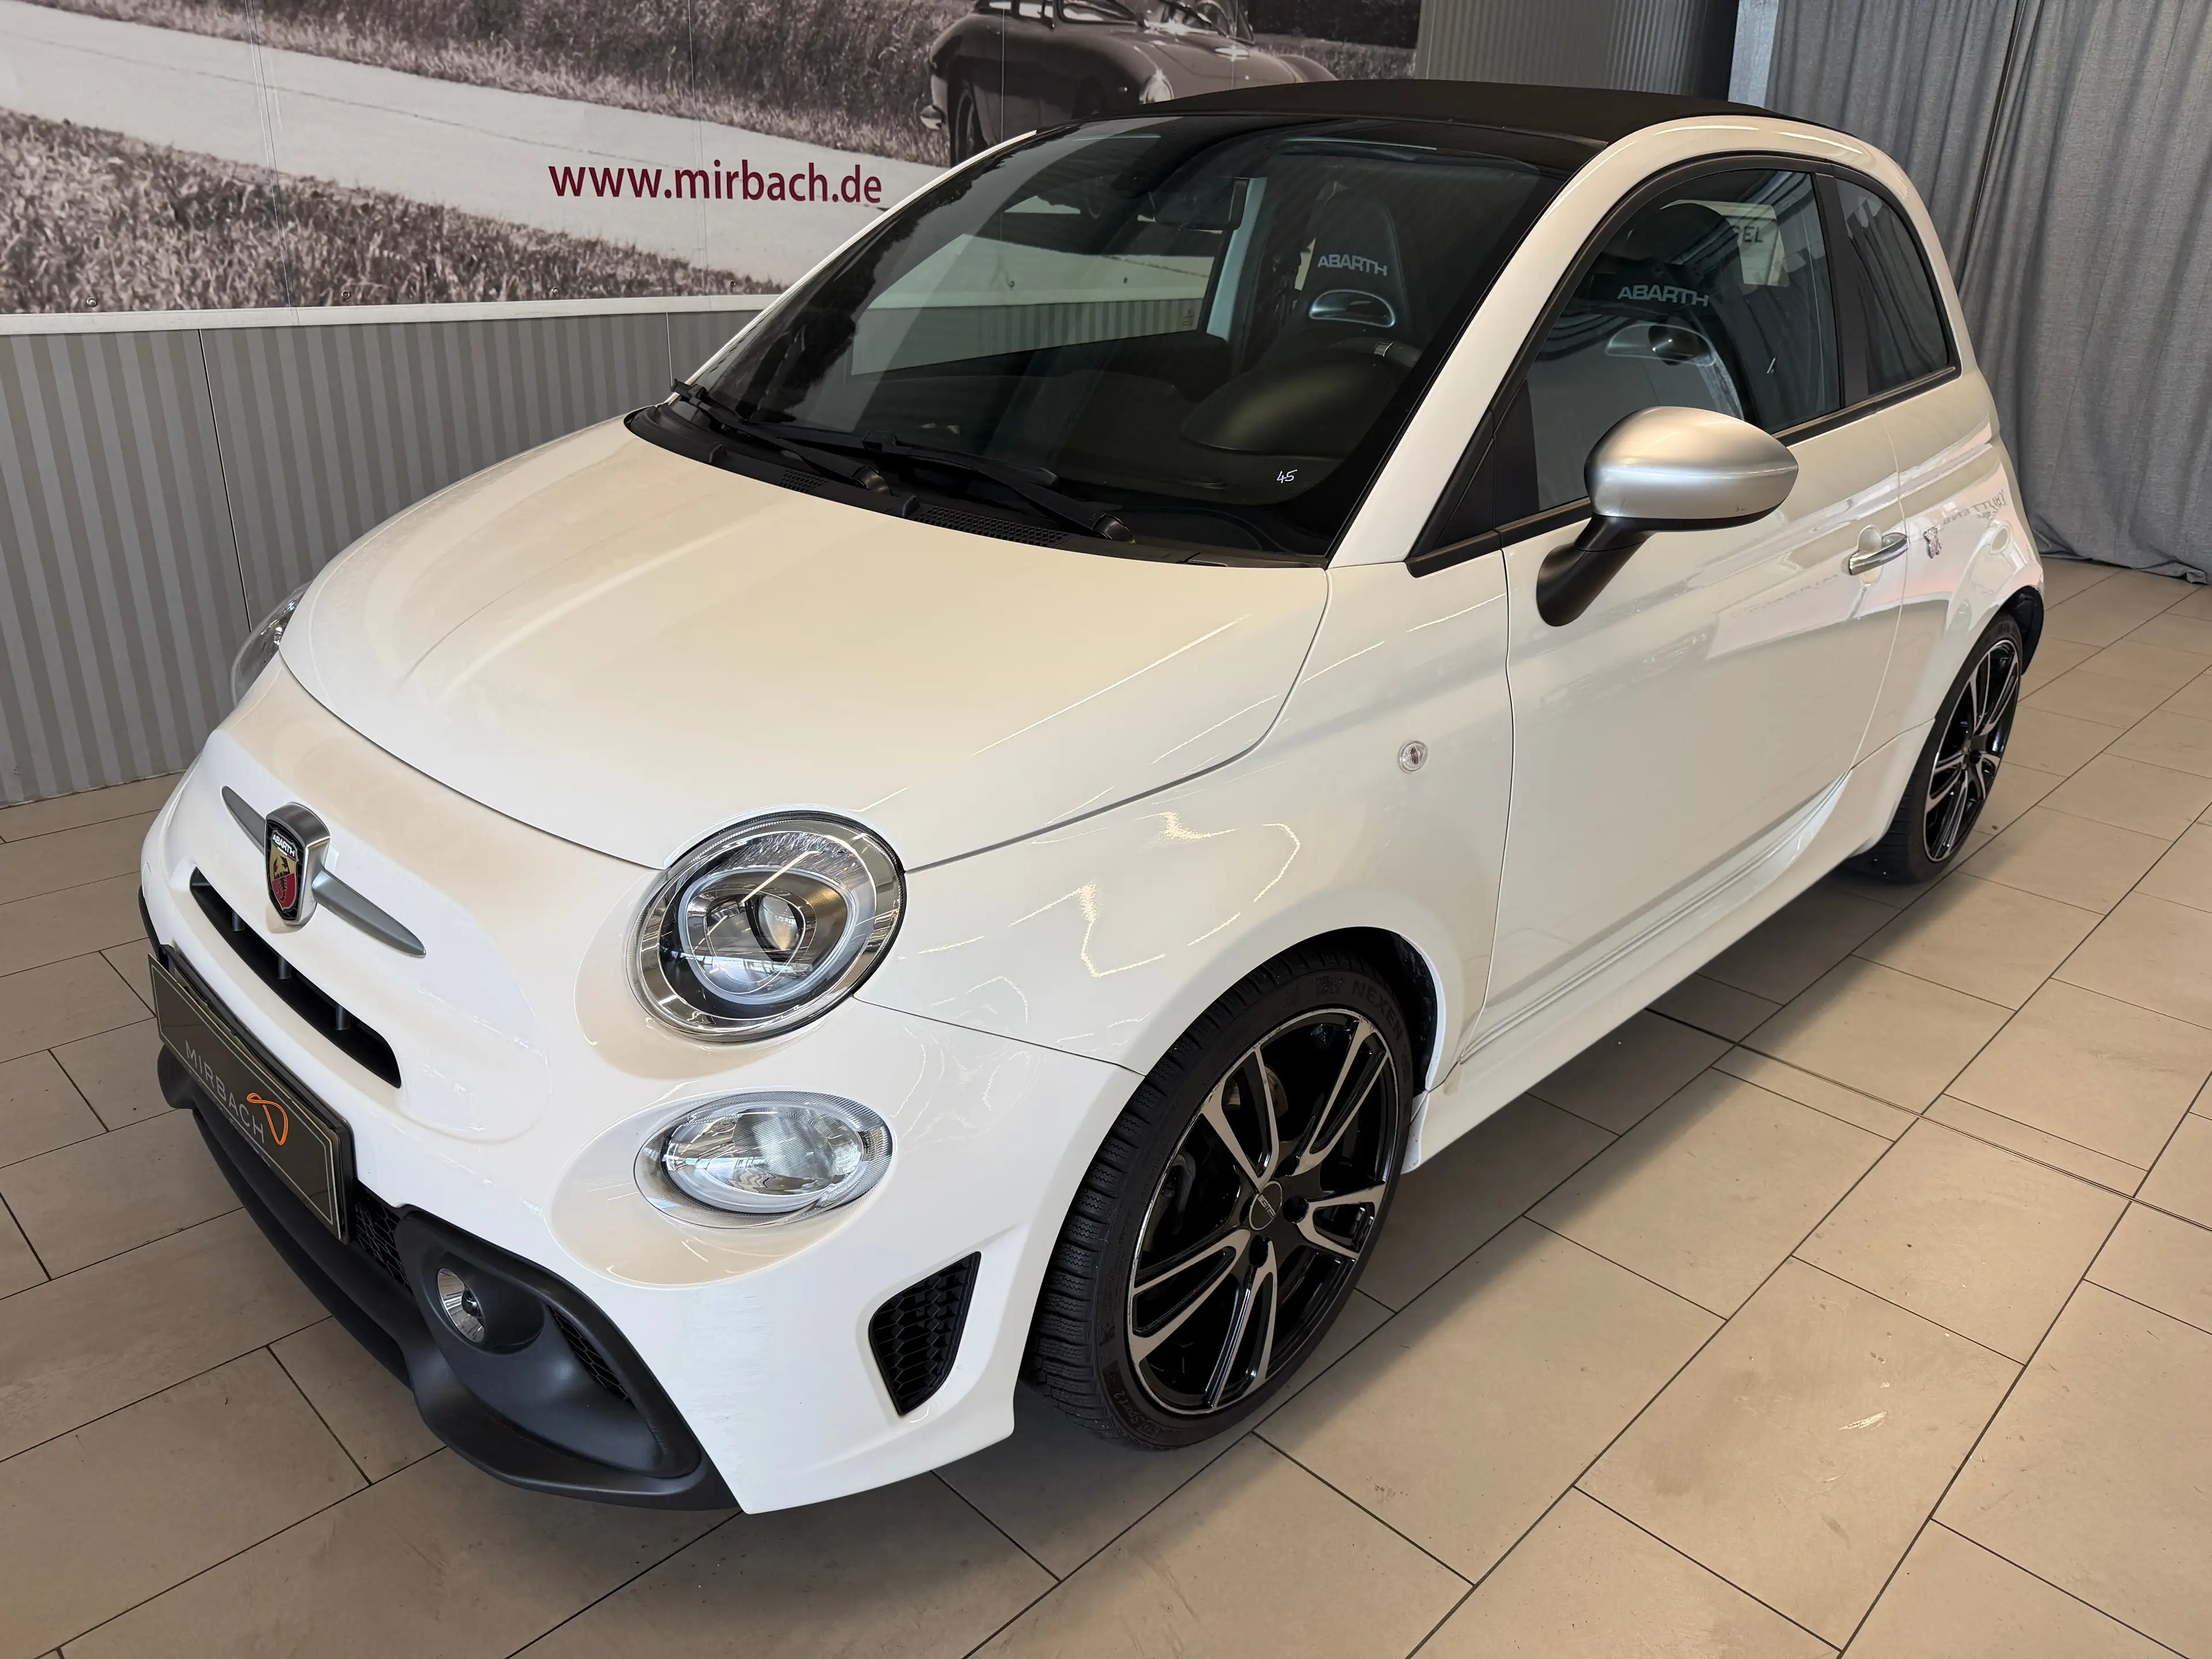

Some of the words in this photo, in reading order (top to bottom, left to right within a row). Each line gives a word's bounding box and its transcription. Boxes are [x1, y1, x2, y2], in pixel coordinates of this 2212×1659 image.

[548, 159, 882, 204] www.mirbach.de
[1317, 253, 1388, 276] ABARTH
[1616, 284, 1710, 306] ABARTH
[1276, 469, 1298, 484] 45
[272, 834, 296, 857] ABARTH
[1351, 979, 1404, 1041] NEXEN
[184, 1040, 266, 1143] MIRBACH
